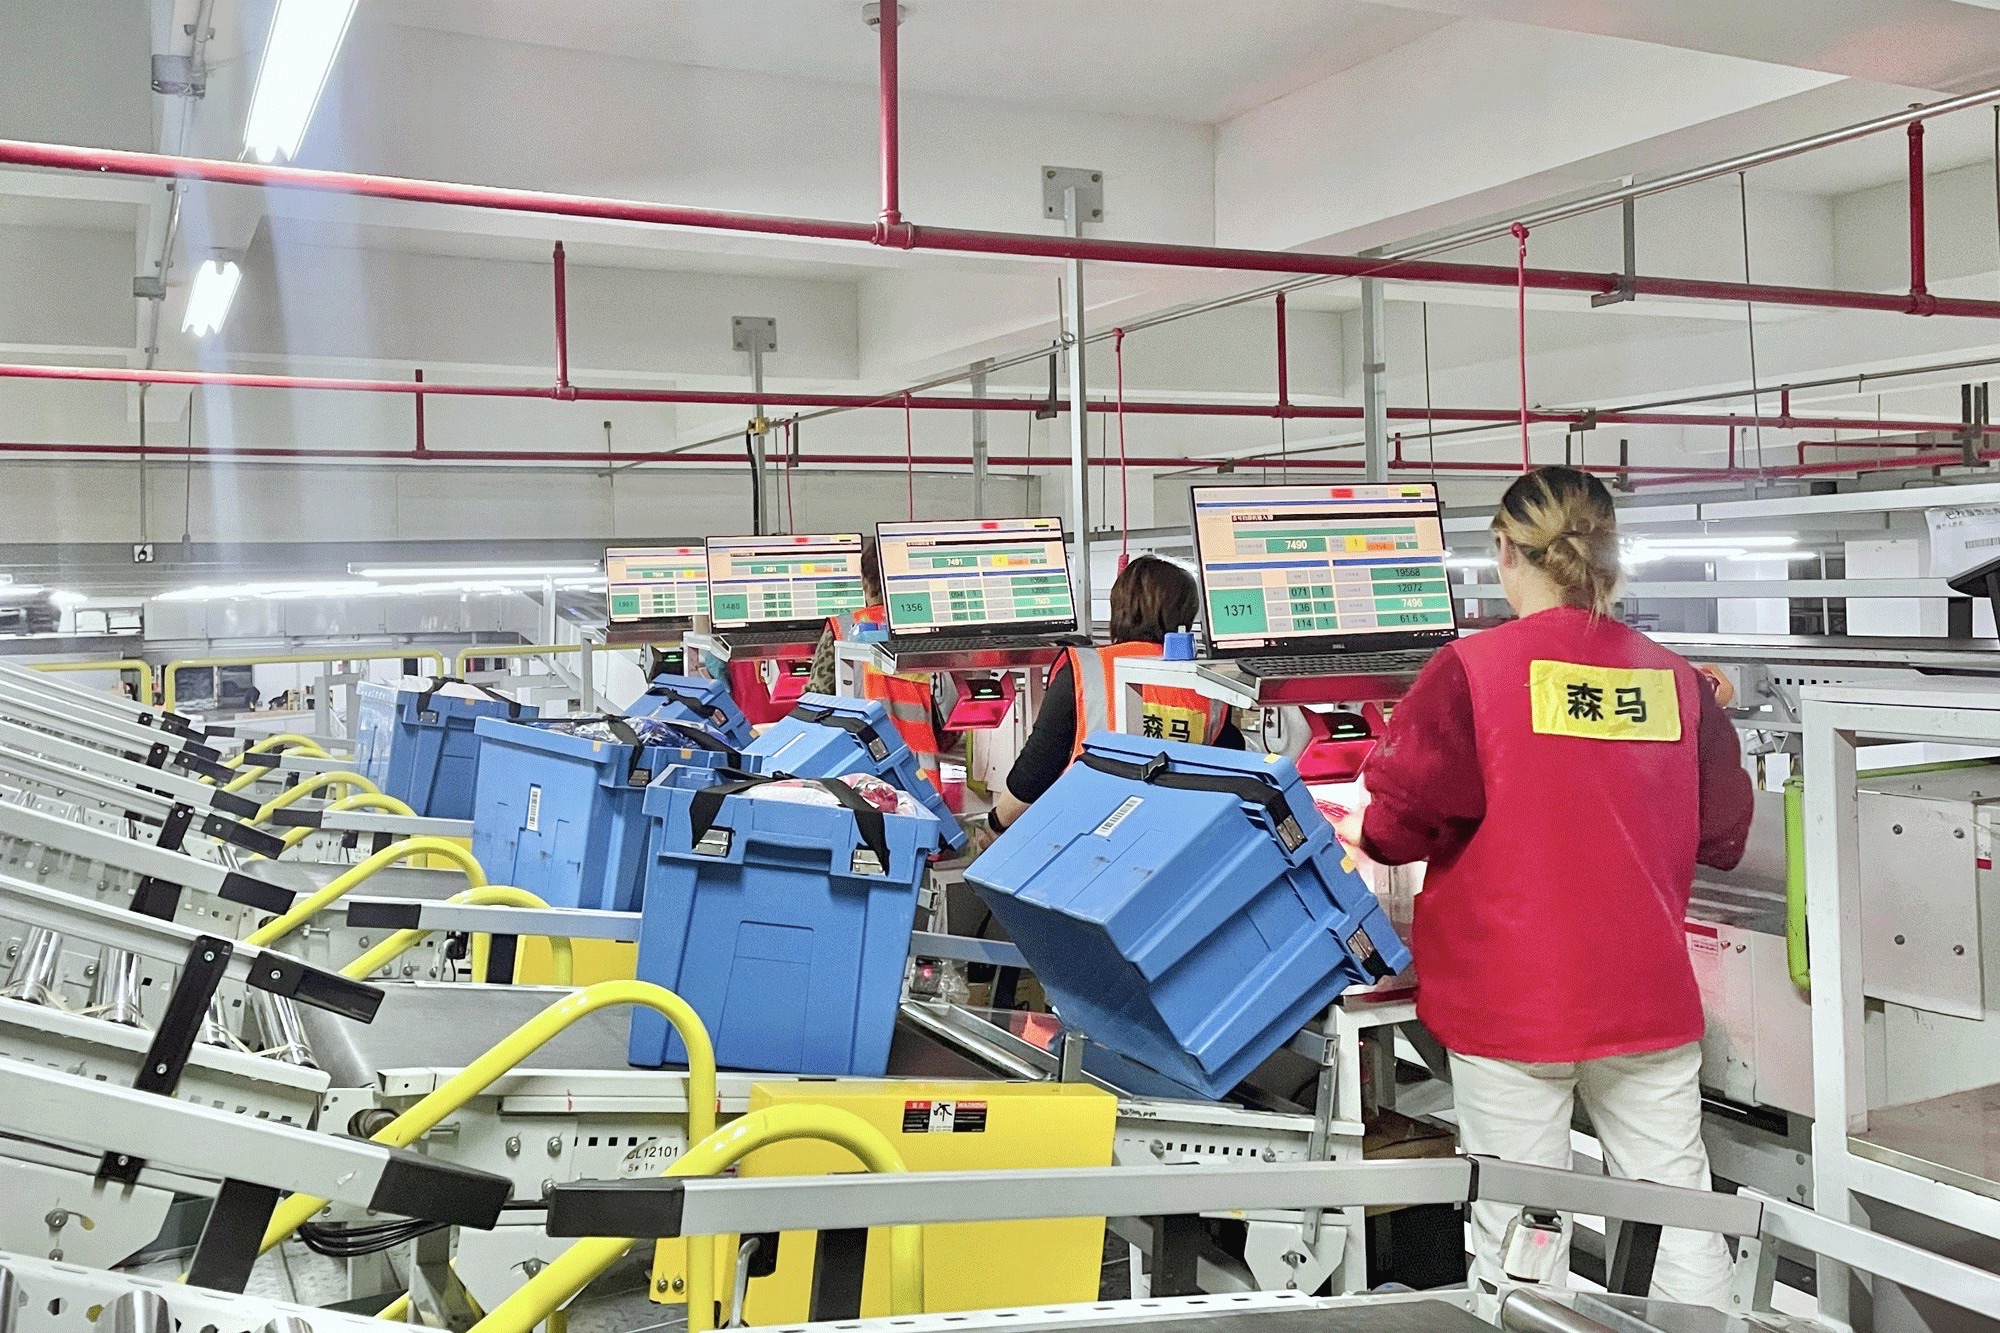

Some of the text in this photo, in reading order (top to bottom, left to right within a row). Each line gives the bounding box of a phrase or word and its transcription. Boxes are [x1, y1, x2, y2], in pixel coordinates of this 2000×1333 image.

[1285, 540, 1307, 549] 7490
[1291, 587, 1325, 597] 071 1
[1397, 583, 1423, 592] 12072
[901, 603, 923, 612] 1356
[1294, 602, 1327, 612] 136 1
[1401, 598, 1423, 607] 7496
[1224, 604, 1253, 616] 1371
[1296, 619, 1312, 628] 114
[1567, 683, 1647, 722] 森马
[1142, 714, 1190, 743] 森马
[626, 1146, 679, 1160] CL12101
